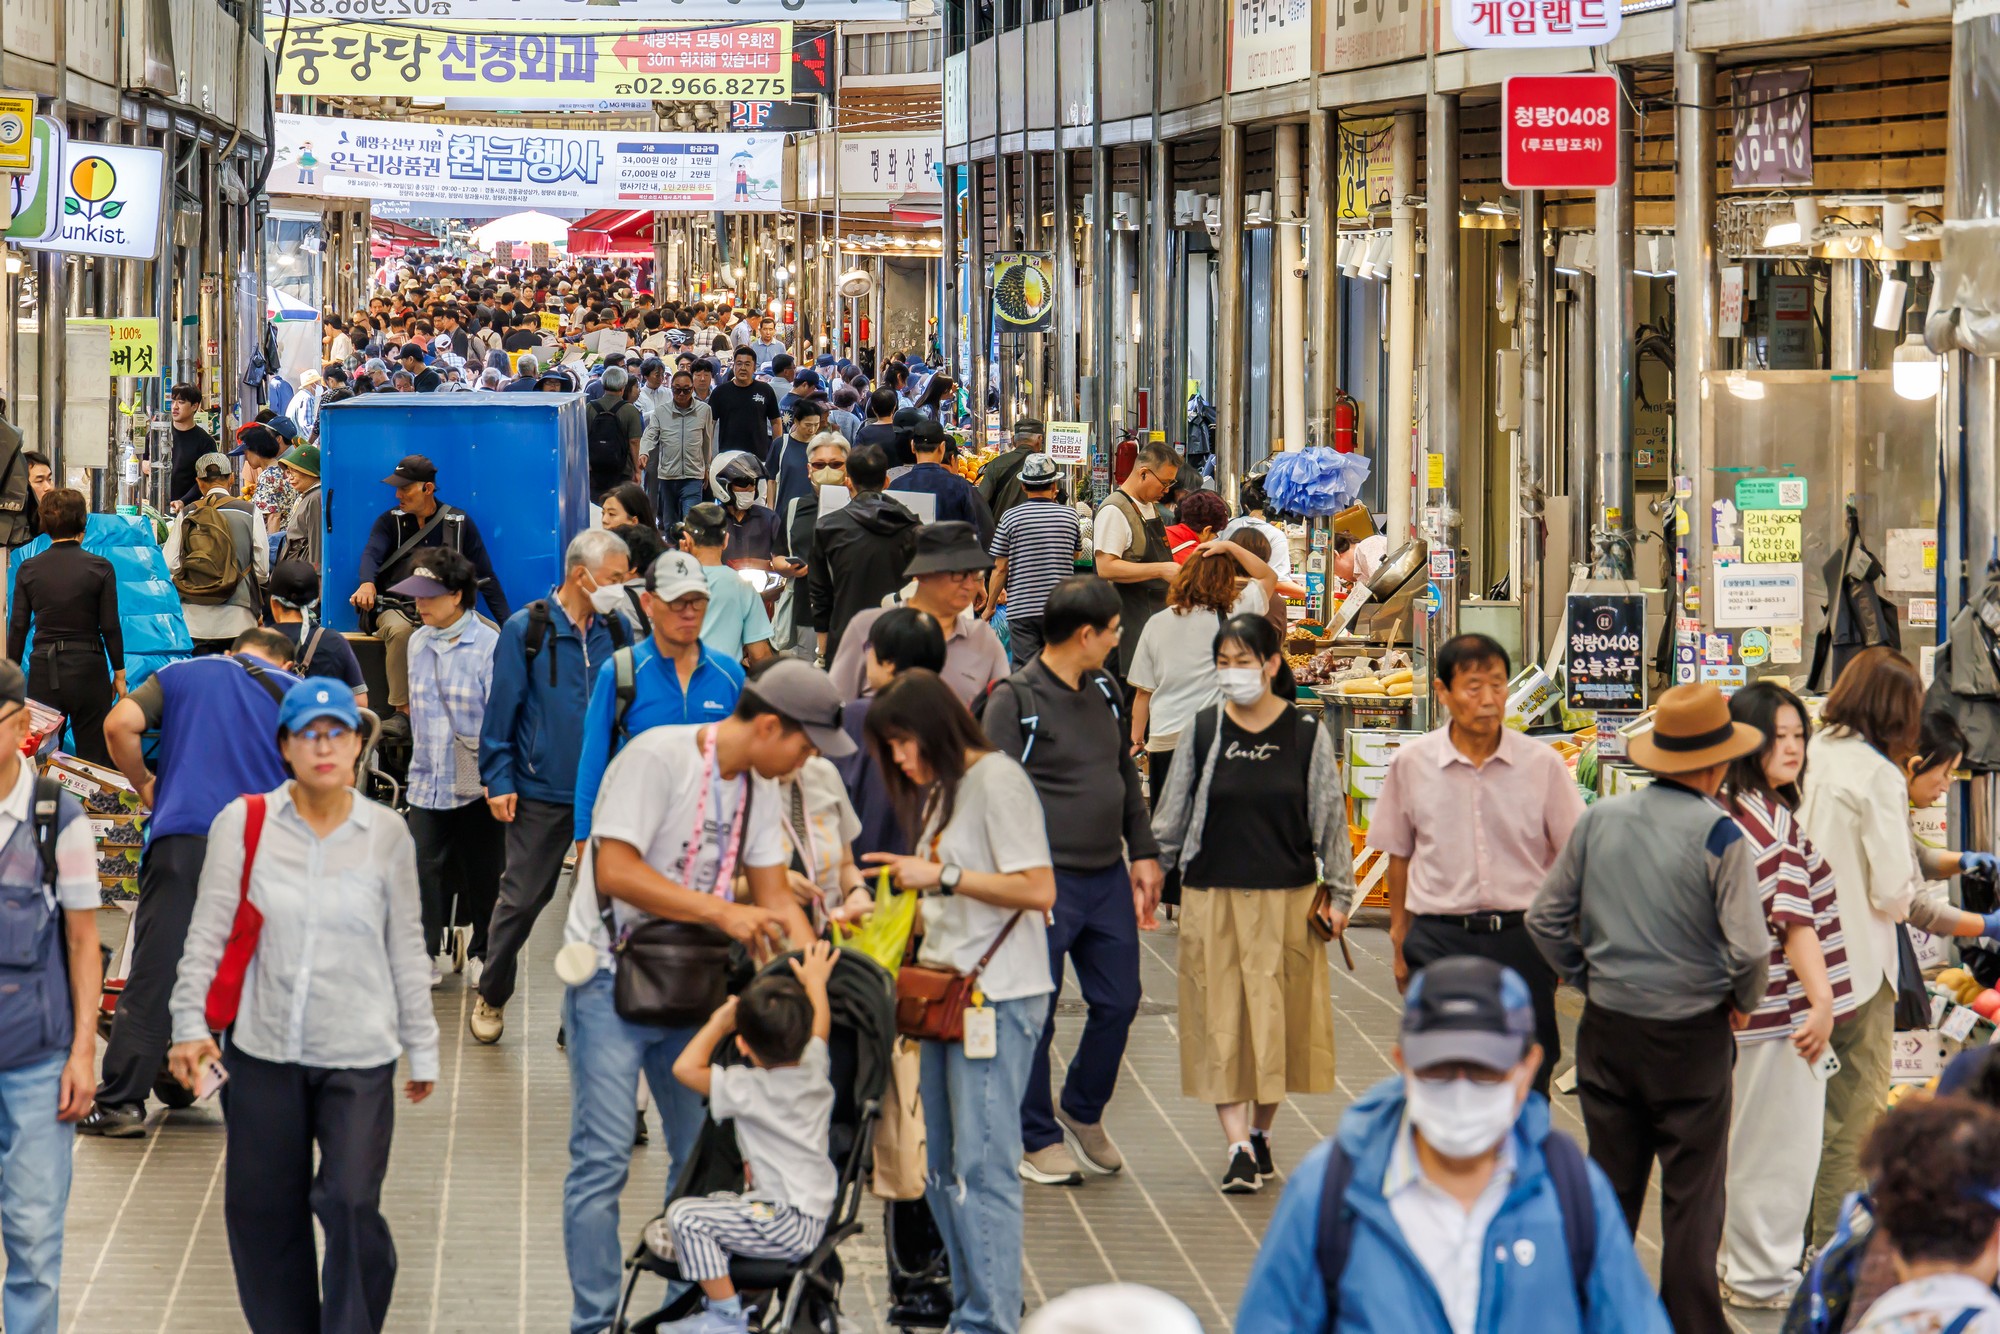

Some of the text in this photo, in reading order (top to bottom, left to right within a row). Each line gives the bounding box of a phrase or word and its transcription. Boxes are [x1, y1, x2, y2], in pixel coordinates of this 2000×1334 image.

[1470, 0, 1608, 36] 게임랜드
[642, 32, 775, 49] 세광약국 모퉁이 우회전
[273, 27, 599, 85] 풍당당 신경외과
[647, 52, 770, 69] 30m 위치해 있습니다
[633, 77, 785, 95] 02.966.8275
[1513, 106, 1610, 128] 청량0408
[355, 135, 442, 153] 해양수산부 지원
[1521, 137, 1603, 153] (루프탑포차)
[329, 151, 441, 178] 온누리상품권
[446, 133, 604, 185] 환급행사
[622, 155, 712, 166] 34,000원 이상 1만원
[621, 169, 711, 179] 67,000원 이상 2만원
[62, 223, 126, 245] unkist
[119, 326, 142, 341] 100%
[110, 344, 153, 374] 버섯
[1052, 435, 1082, 445] 환급행사
[1051, 445, 1081, 454] 참여점포
[1749, 537, 1795, 550] 성창상회
[1570, 633, 1640, 653] 청량0408
[1570, 656, 1640, 680] 오늘휴무
